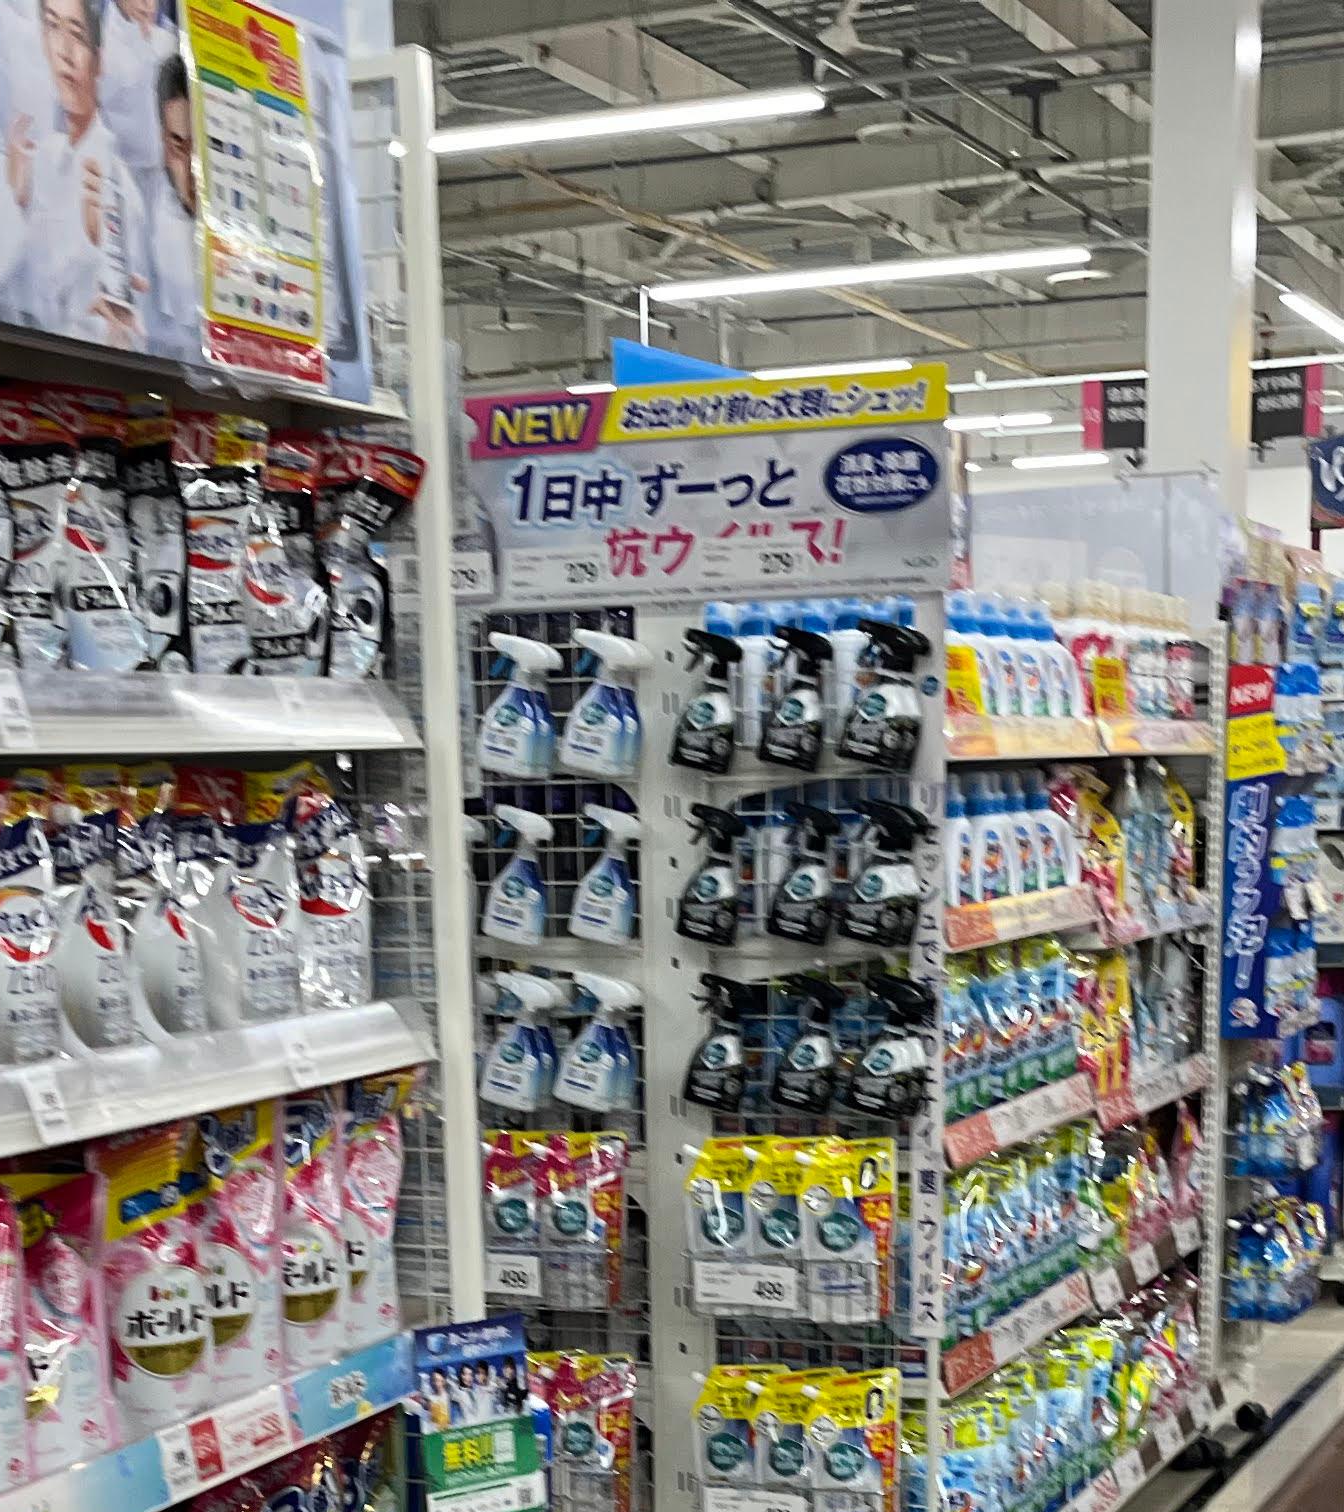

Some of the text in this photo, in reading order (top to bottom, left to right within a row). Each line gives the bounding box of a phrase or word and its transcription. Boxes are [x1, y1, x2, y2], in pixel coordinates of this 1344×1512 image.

[489, 402, 590, 450] NEW
[513, 464, 623, 521] 1日中
[640, 457, 796, 514] ずーっと
[499, 1268, 529, 1290] 499
[753, 1280, 785, 1302] 499
[126, 1305, 205, 1341] ボールド
